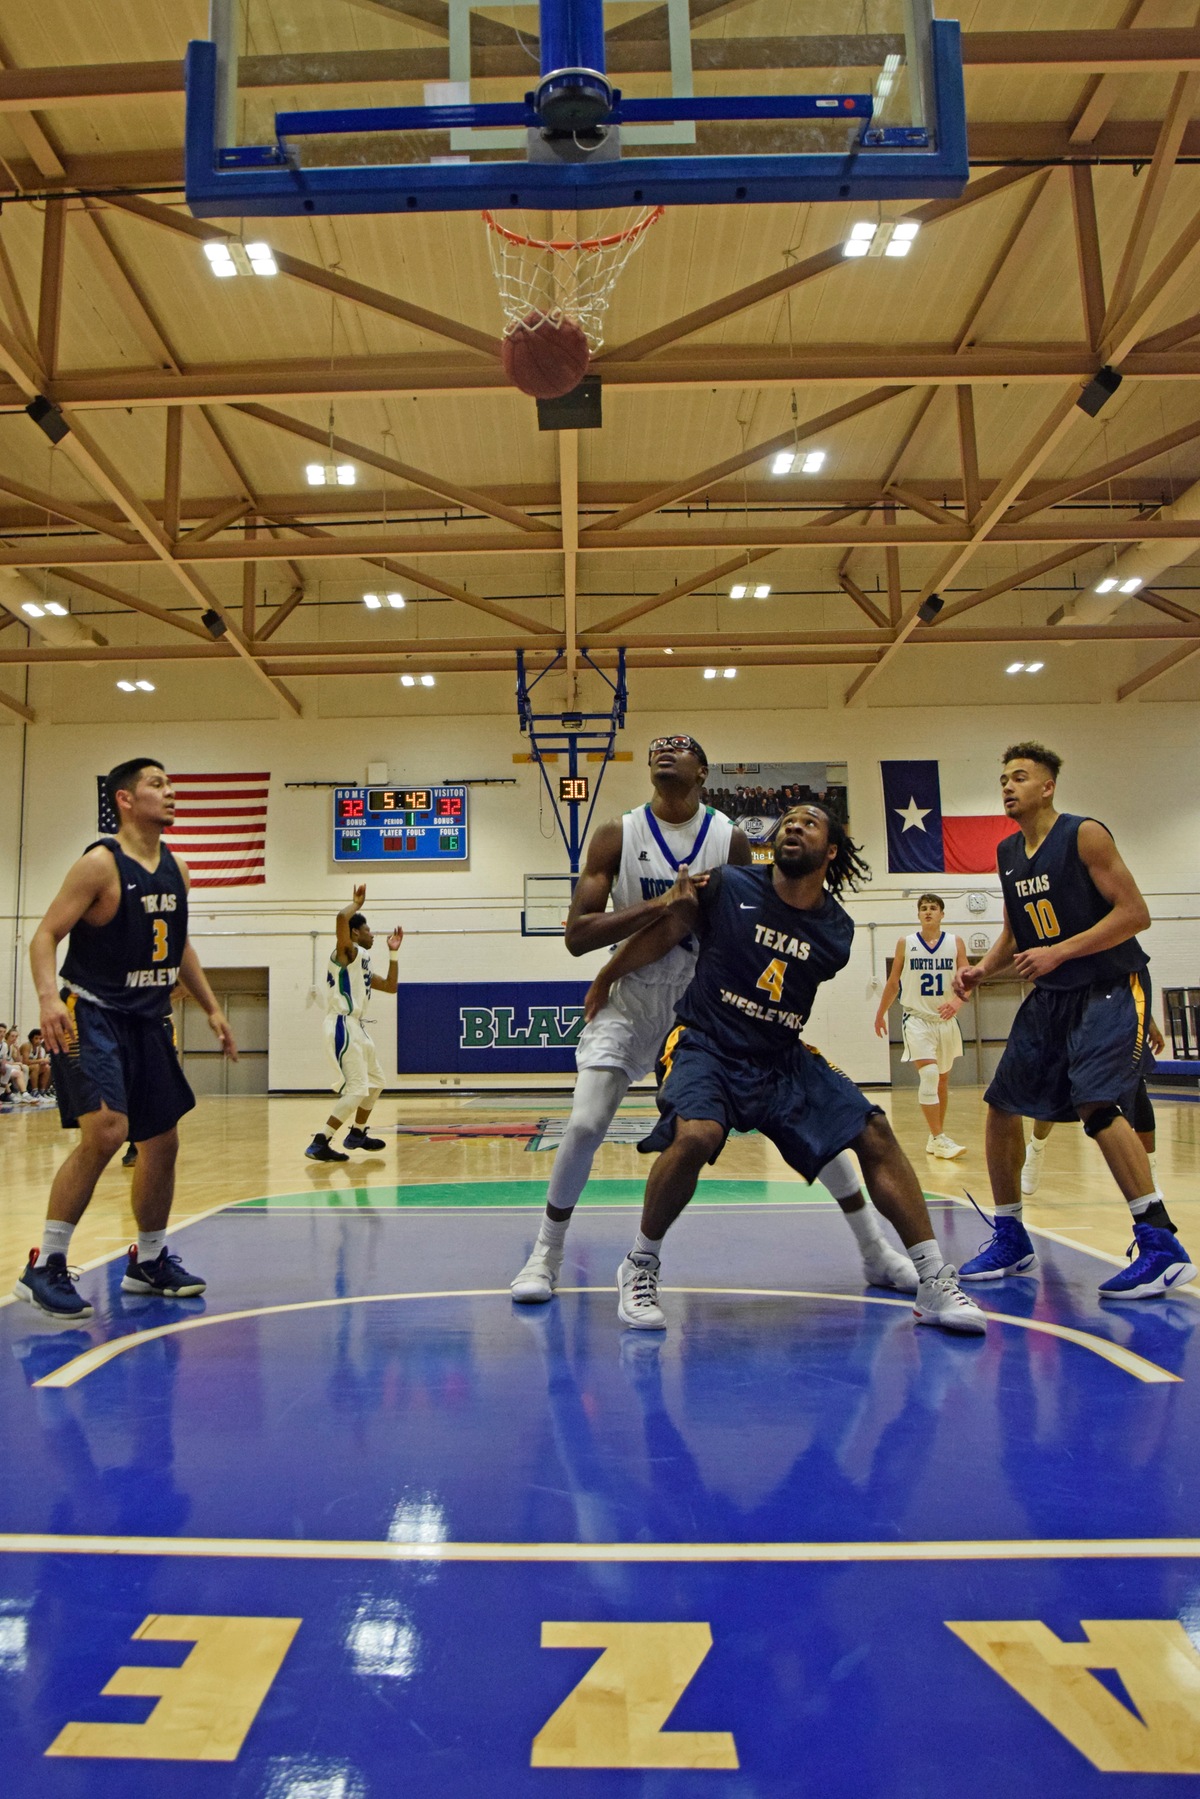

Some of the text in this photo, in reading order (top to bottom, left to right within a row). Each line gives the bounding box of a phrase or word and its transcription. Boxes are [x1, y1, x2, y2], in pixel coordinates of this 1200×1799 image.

[337, 790, 365, 799] HOME
[434, 789, 464, 797] VISITOR
[562, 780, 586, 798] 30
[383, 792, 427, 809] 5:42
[440, 798, 461, 815] 32
[342, 800, 364, 817] 32
[346, 818, 367, 826] BONUS
[433, 817, 454, 825] BONUS
[341, 829, 361, 837] FOULS
[439, 828, 459, 836] FOULS
[351, 838, 360, 851] 4
[449, 836, 458, 850] 6
[751, 852, 765, 861] he
[1015, 873, 1050, 898] TEXAS
[1023, 898, 1061, 940] 10
[152, 919, 168, 962] 3
[754, 924, 811, 961] TEXAS
[974, 938, 986, 948] EXIT
[910, 958, 954, 971] NORTH LAKE
[756, 957, 788, 1003] 4
[920, 973, 944, 996] 21
